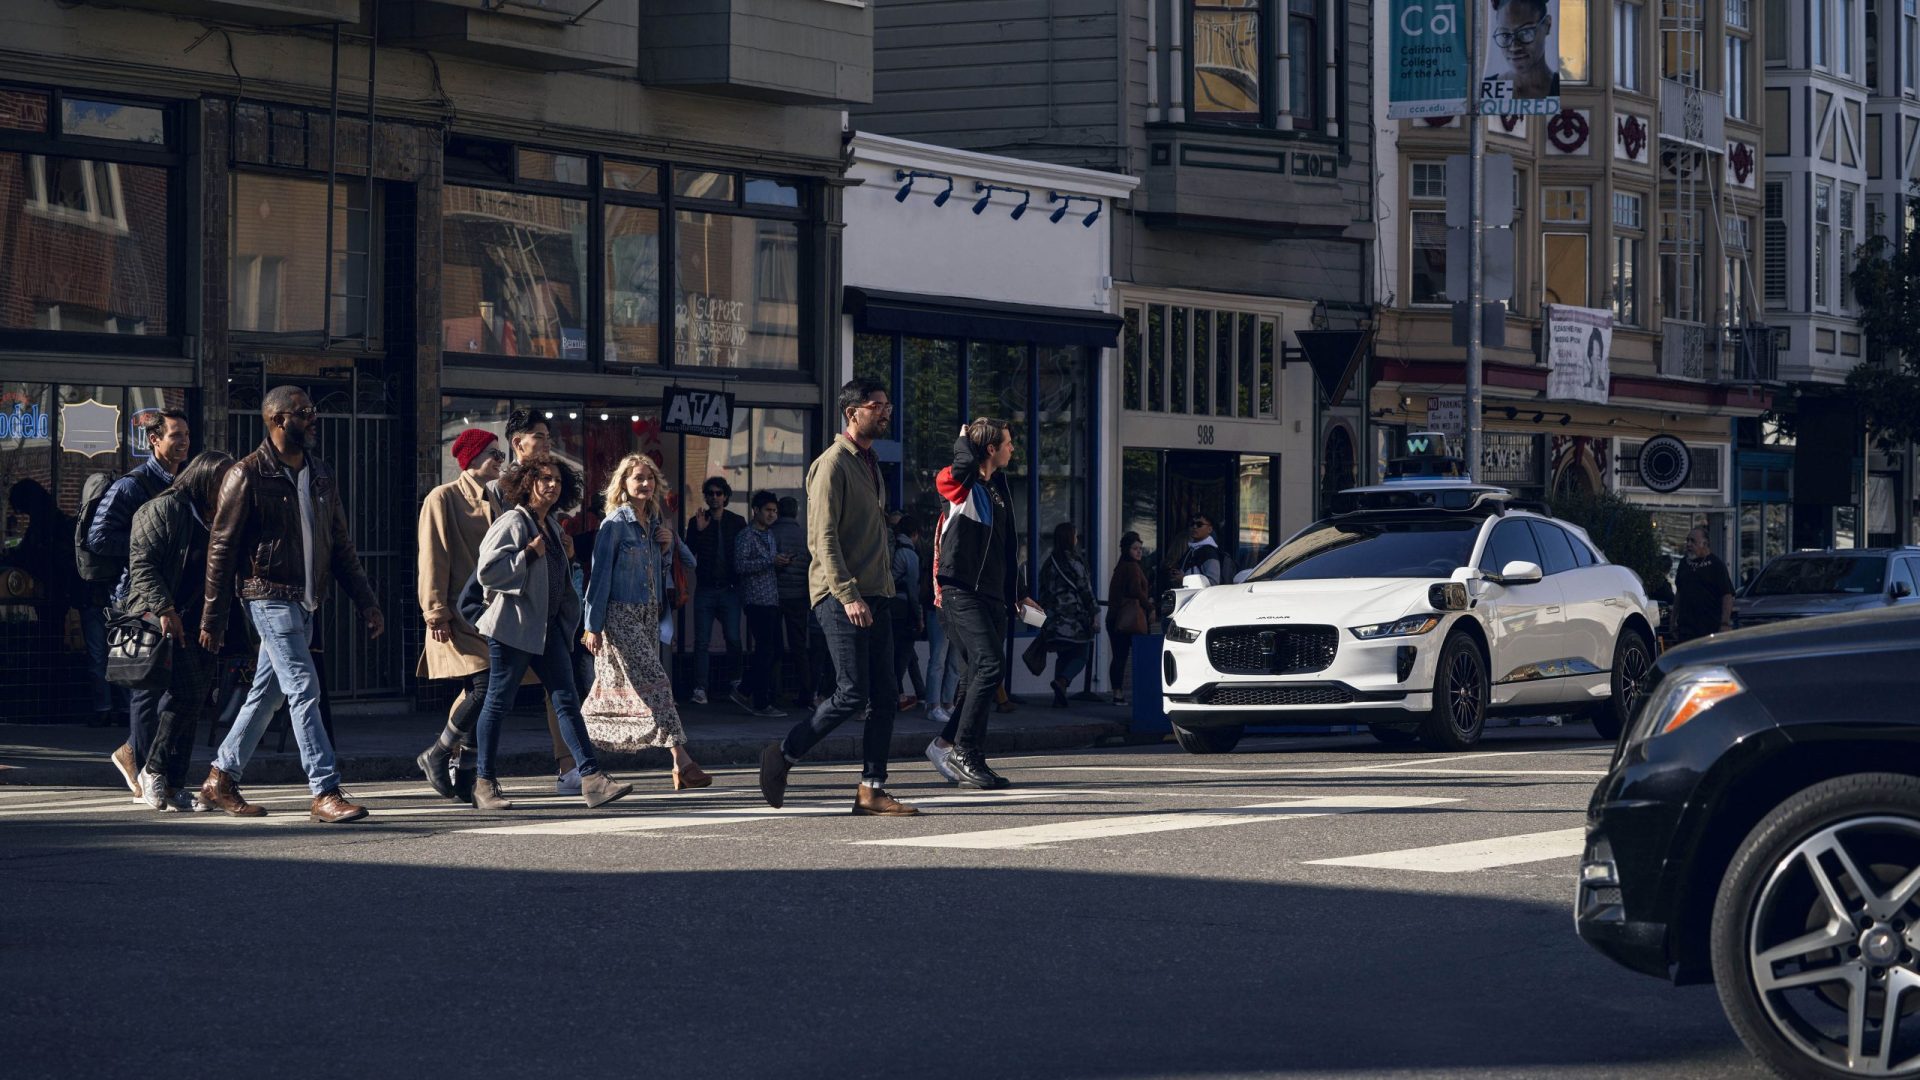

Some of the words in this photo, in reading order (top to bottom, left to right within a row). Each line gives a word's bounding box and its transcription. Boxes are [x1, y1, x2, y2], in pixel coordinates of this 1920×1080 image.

[1400, 44, 1452, 55] California
[1400, 57, 1438, 68] College
[1400, 70, 1413, 79] of
[1414, 69, 1431, 79] the
[1433, 68, 1456, 78] Arts
[1481, 82, 1513, 98] RE-
[1409, 104, 1445, 114] cca.edu
[1481, 99, 1559, 115] QUIRED
[696, 297, 743, 322] SUPPORT
[562, 336, 586, 349] Bernie
[666, 392, 729, 428] ATA
[1428, 399, 1437, 410] NO
[1439, 400, 1461, 409] PARKING
[0, 403, 49, 439] odelo
[1197, 424, 1214, 445] 988
